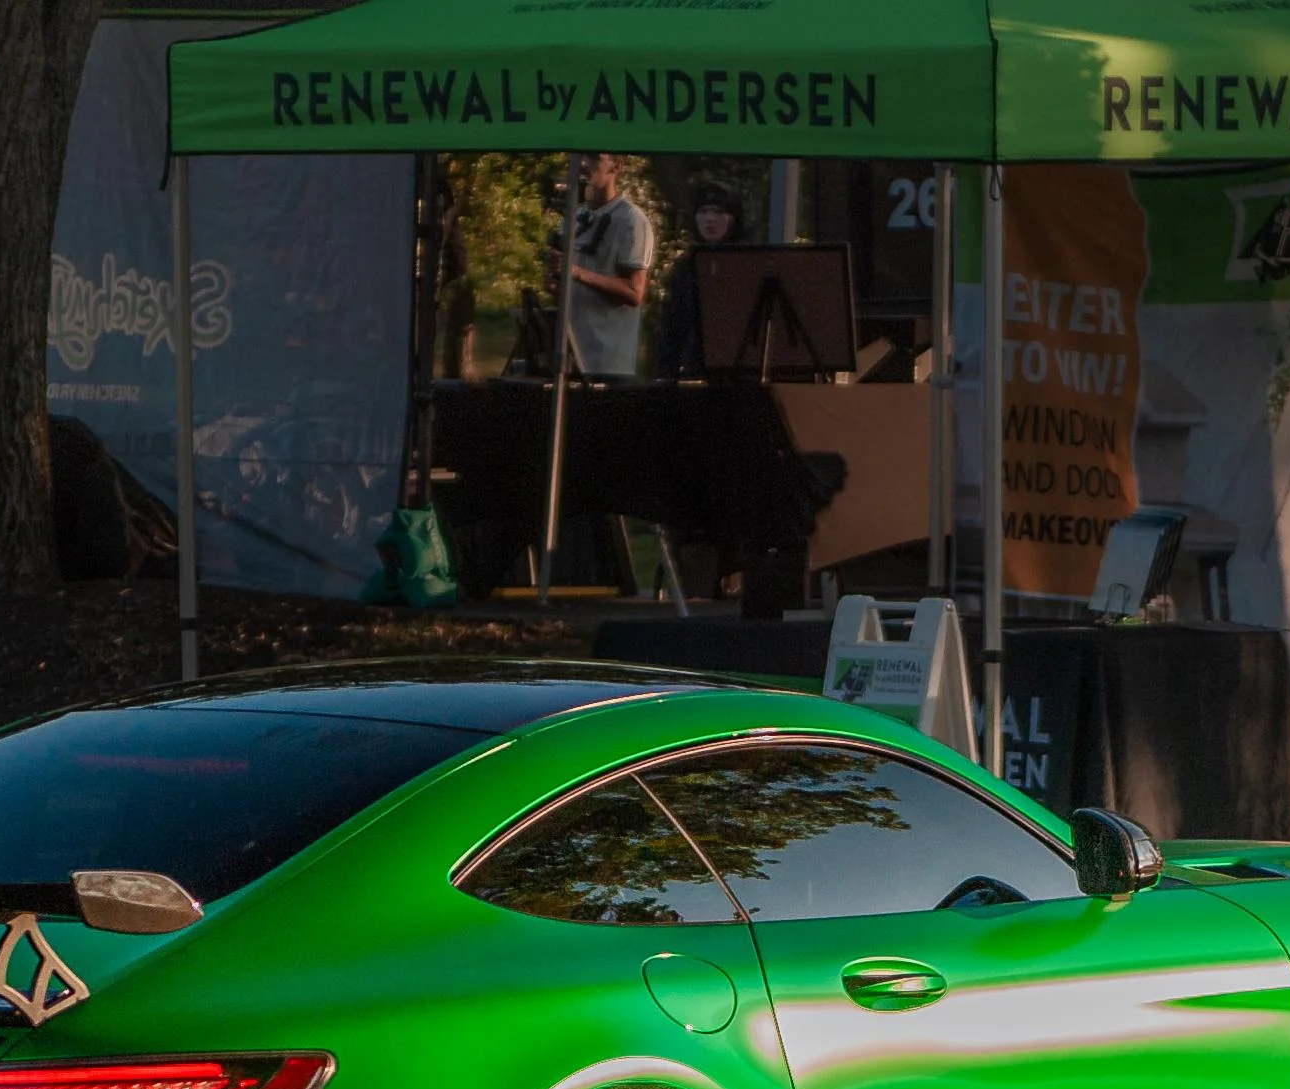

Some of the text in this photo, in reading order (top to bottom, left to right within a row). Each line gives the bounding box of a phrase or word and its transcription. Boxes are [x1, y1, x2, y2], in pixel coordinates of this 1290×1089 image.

[273, 69, 876, 127] RENEWAL by ANDERSEN
[1002, 339, 1048, 384] TO
[877, 659, 923, 673] RENEWAL
